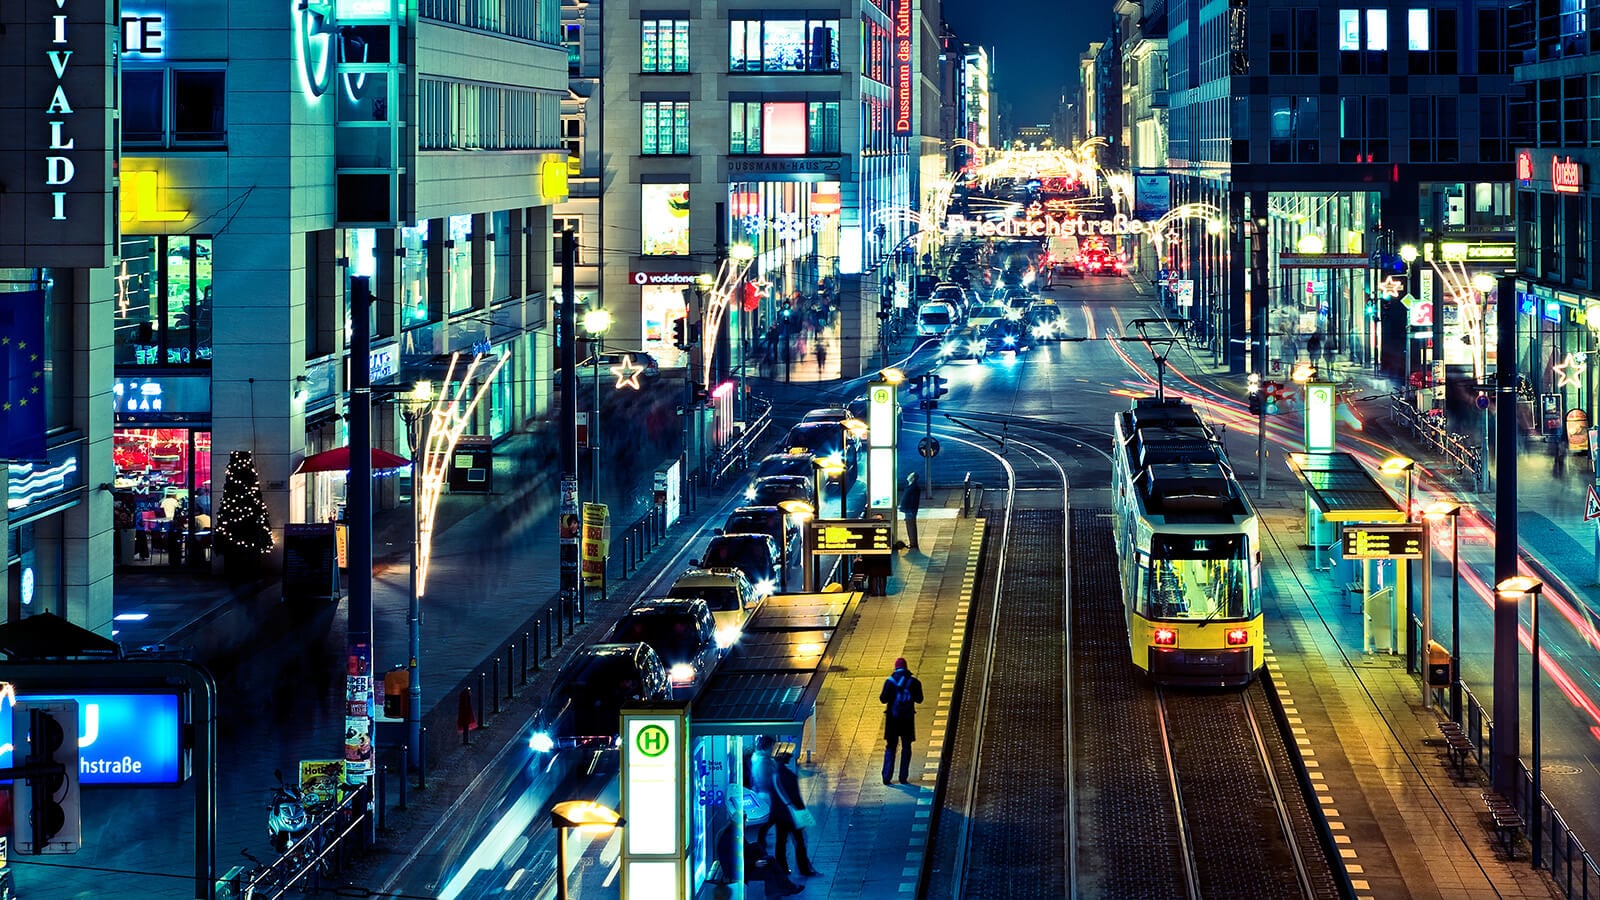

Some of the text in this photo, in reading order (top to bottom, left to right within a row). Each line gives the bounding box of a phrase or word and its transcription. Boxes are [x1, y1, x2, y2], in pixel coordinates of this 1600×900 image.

[897, 0, 910, 131] Dussmann das Kultu
[728, 161, 819, 171] DUSSMANN-HAUS
[1552, 155, 1578, 191] Cornelsen
[947, 214, 1145, 236] Friedrichstraße
[650, 274, 695, 284] vodafone
[645, 732, 661, 750] H
[80, 756, 142, 774] hstraße
